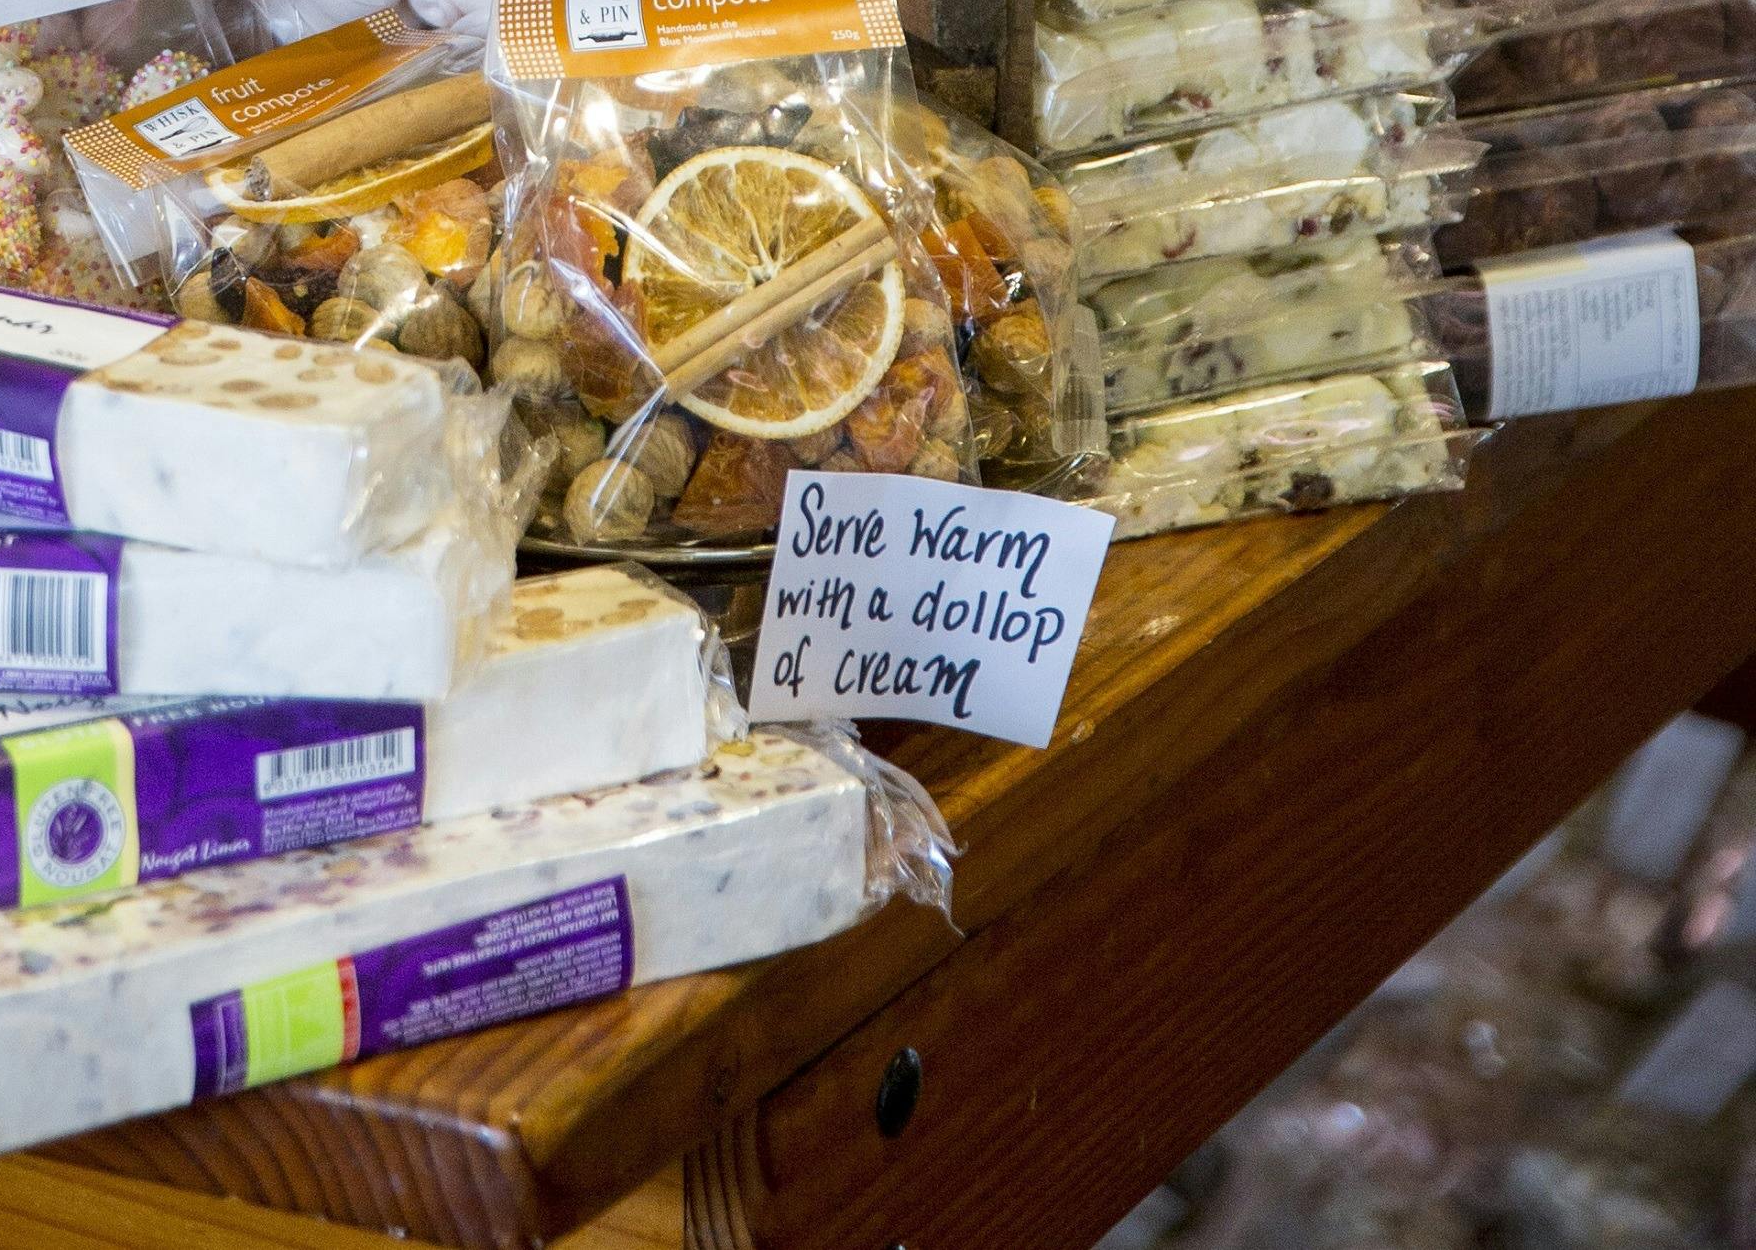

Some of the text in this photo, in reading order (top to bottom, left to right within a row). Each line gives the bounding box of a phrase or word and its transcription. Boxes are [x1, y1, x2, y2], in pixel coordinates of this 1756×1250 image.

[580, 4, 631, 25] & PIN
[657, 18, 738, 35] Handmade the
[211, 77, 266, 106] fruit
[231, 76, 335, 124] compote
[144, 103, 199, 135] WHISK
[190, 128, 220, 145] PIN
[793, 482, 887, 558] Serve
[777, 577, 1065, 664] with a dollop
[774, 635, 981, 719] of cream
